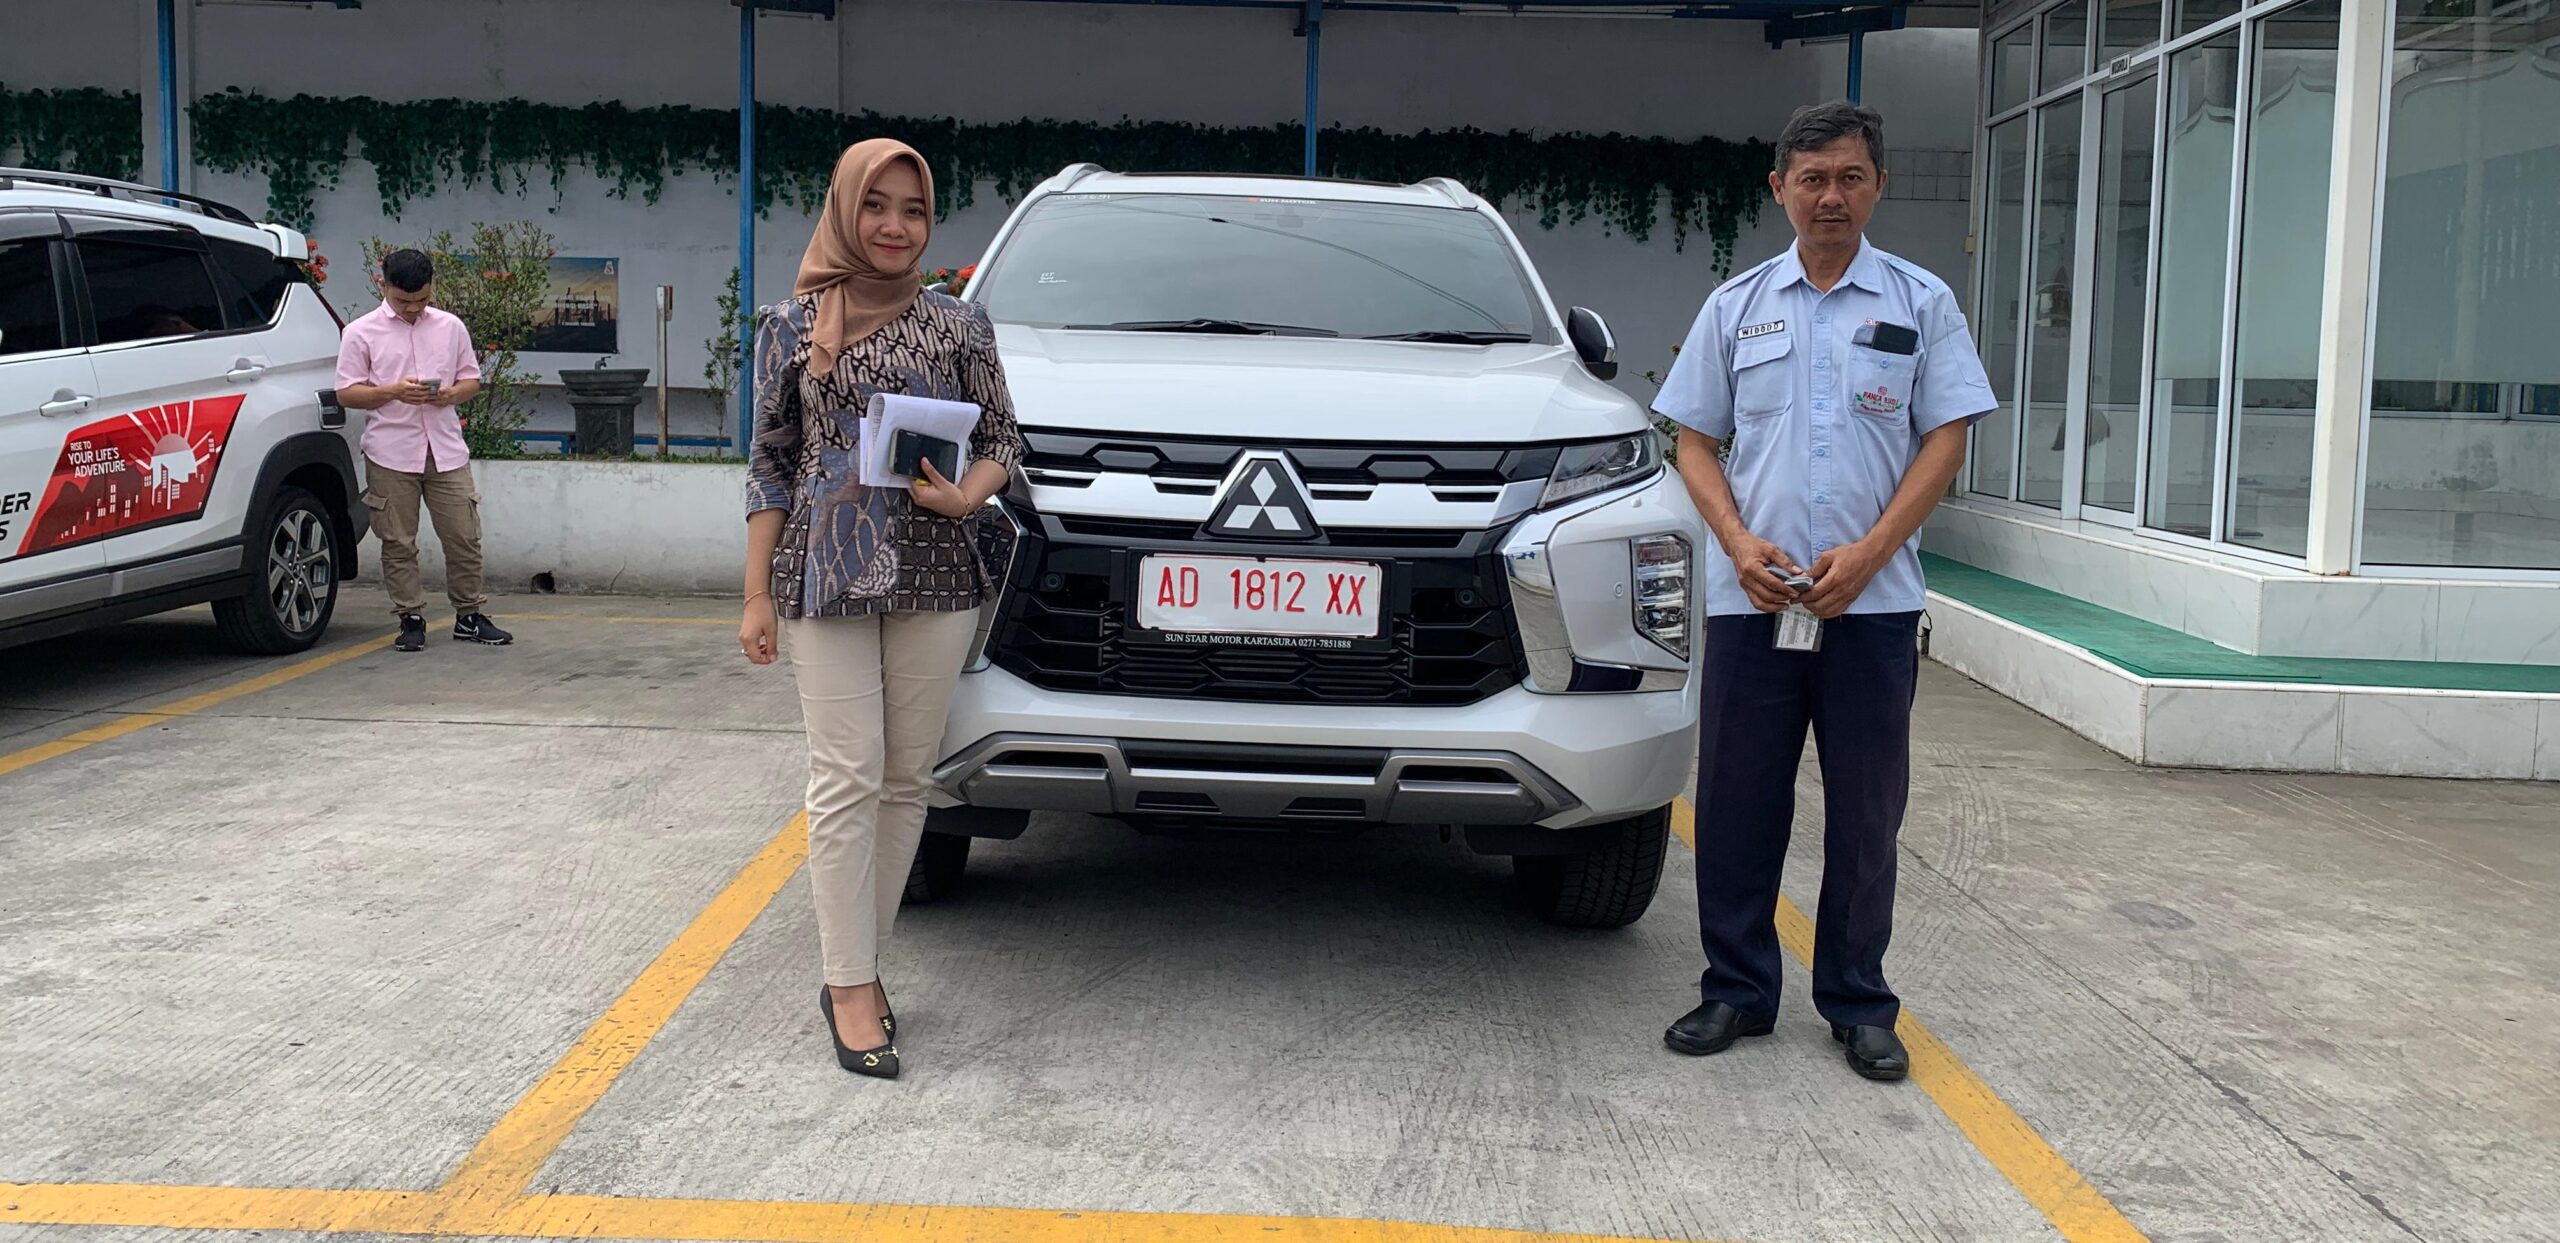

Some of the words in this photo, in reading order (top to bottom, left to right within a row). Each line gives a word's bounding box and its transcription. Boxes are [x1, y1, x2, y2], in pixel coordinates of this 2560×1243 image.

[70, 443, 82, 451] RISE
[83, 441, 91, 449] TO
[68, 450, 93, 465] YOUR
[96, 448, 120, 461] LIFE'S
[74, 460, 126, 478] ADVENTURE
[0, 491, 31, 515] ER
[1157, 566, 1199, 608] AD
[1230, 568, 1306, 613] 1812
[1326, 573, 1366, 616] XX
[1165, 633, 1184, 642] SUN
[1185, 634, 1208, 643] STAR
[1209, 635, 1242, 645] MOTOR
[1243, 637, 1297, 647] KARTASURA
[1298, 638, 1352, 649] 0271-7851888
